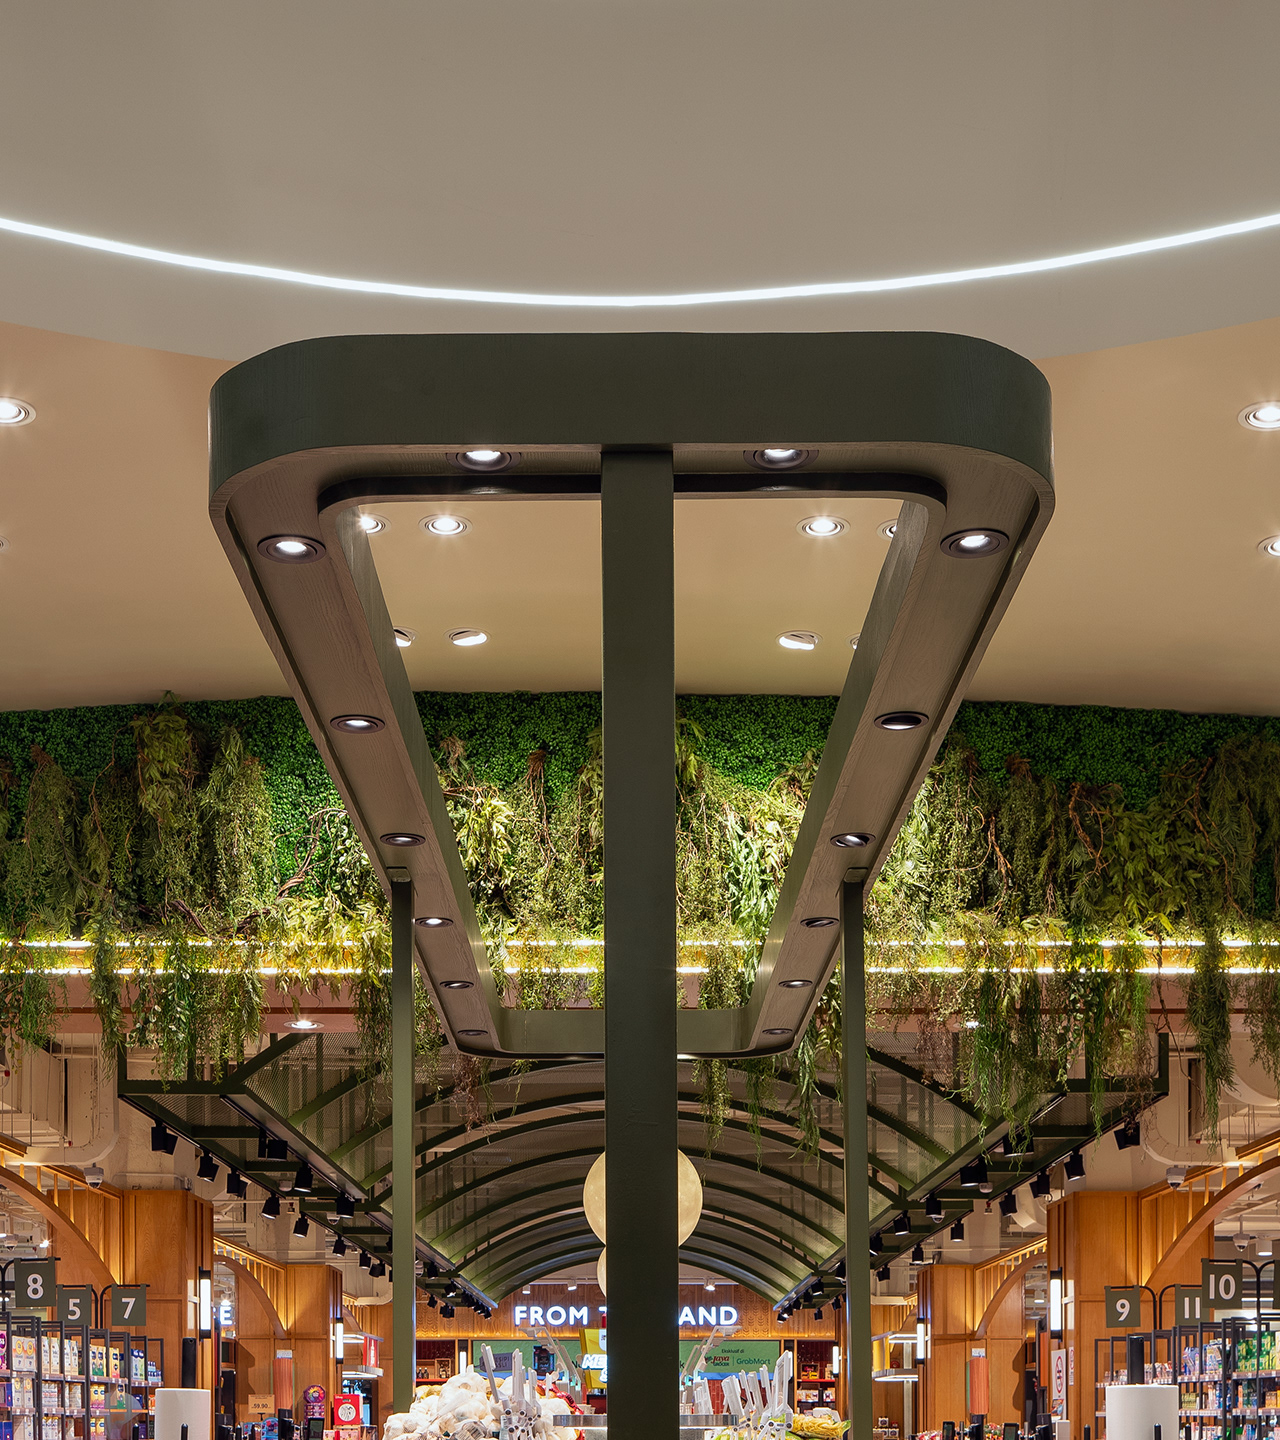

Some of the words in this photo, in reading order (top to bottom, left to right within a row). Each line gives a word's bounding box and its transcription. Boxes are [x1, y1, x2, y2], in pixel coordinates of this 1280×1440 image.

[26, 1273, 44, 1300] 8
[1209, 1273, 1236, 1300] 10
[67, 1298, 81, 1320] 5
[121, 1297, 136, 1320] 7
[514, 1305, 589, 1326] FROM
[677, 1305, 739, 1326] AND
[1115, 1298, 1131, 1322] 9
[1184, 1296, 1201, 1319] 11
[736, 1357, 771, 1365] GrabMart
